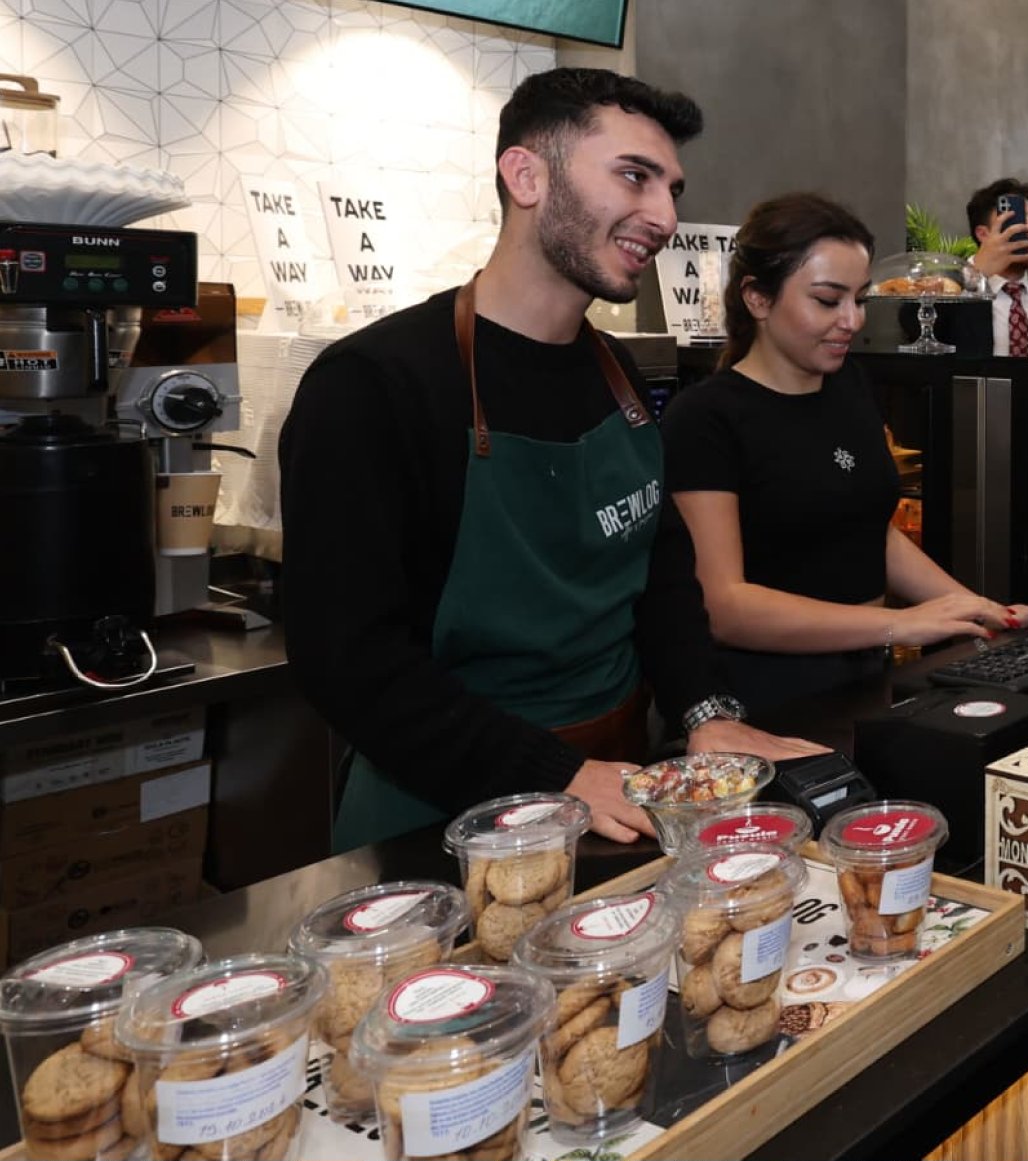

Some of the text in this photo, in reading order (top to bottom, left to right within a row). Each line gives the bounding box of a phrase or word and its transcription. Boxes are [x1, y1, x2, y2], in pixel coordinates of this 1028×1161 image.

[250, 190, 296, 216] TAKE
[330, 196, 386, 220] TAKE
[72, 236, 120, 247] BUNN
[278, 227, 290, 248] A
[360, 232, 375, 252] A
[666, 233, 709, 251] AKE
[270, 260, 307, 283] WAY
[685, 260, 699, 278] A
[596, 479, 660, 538] BREWLOG
